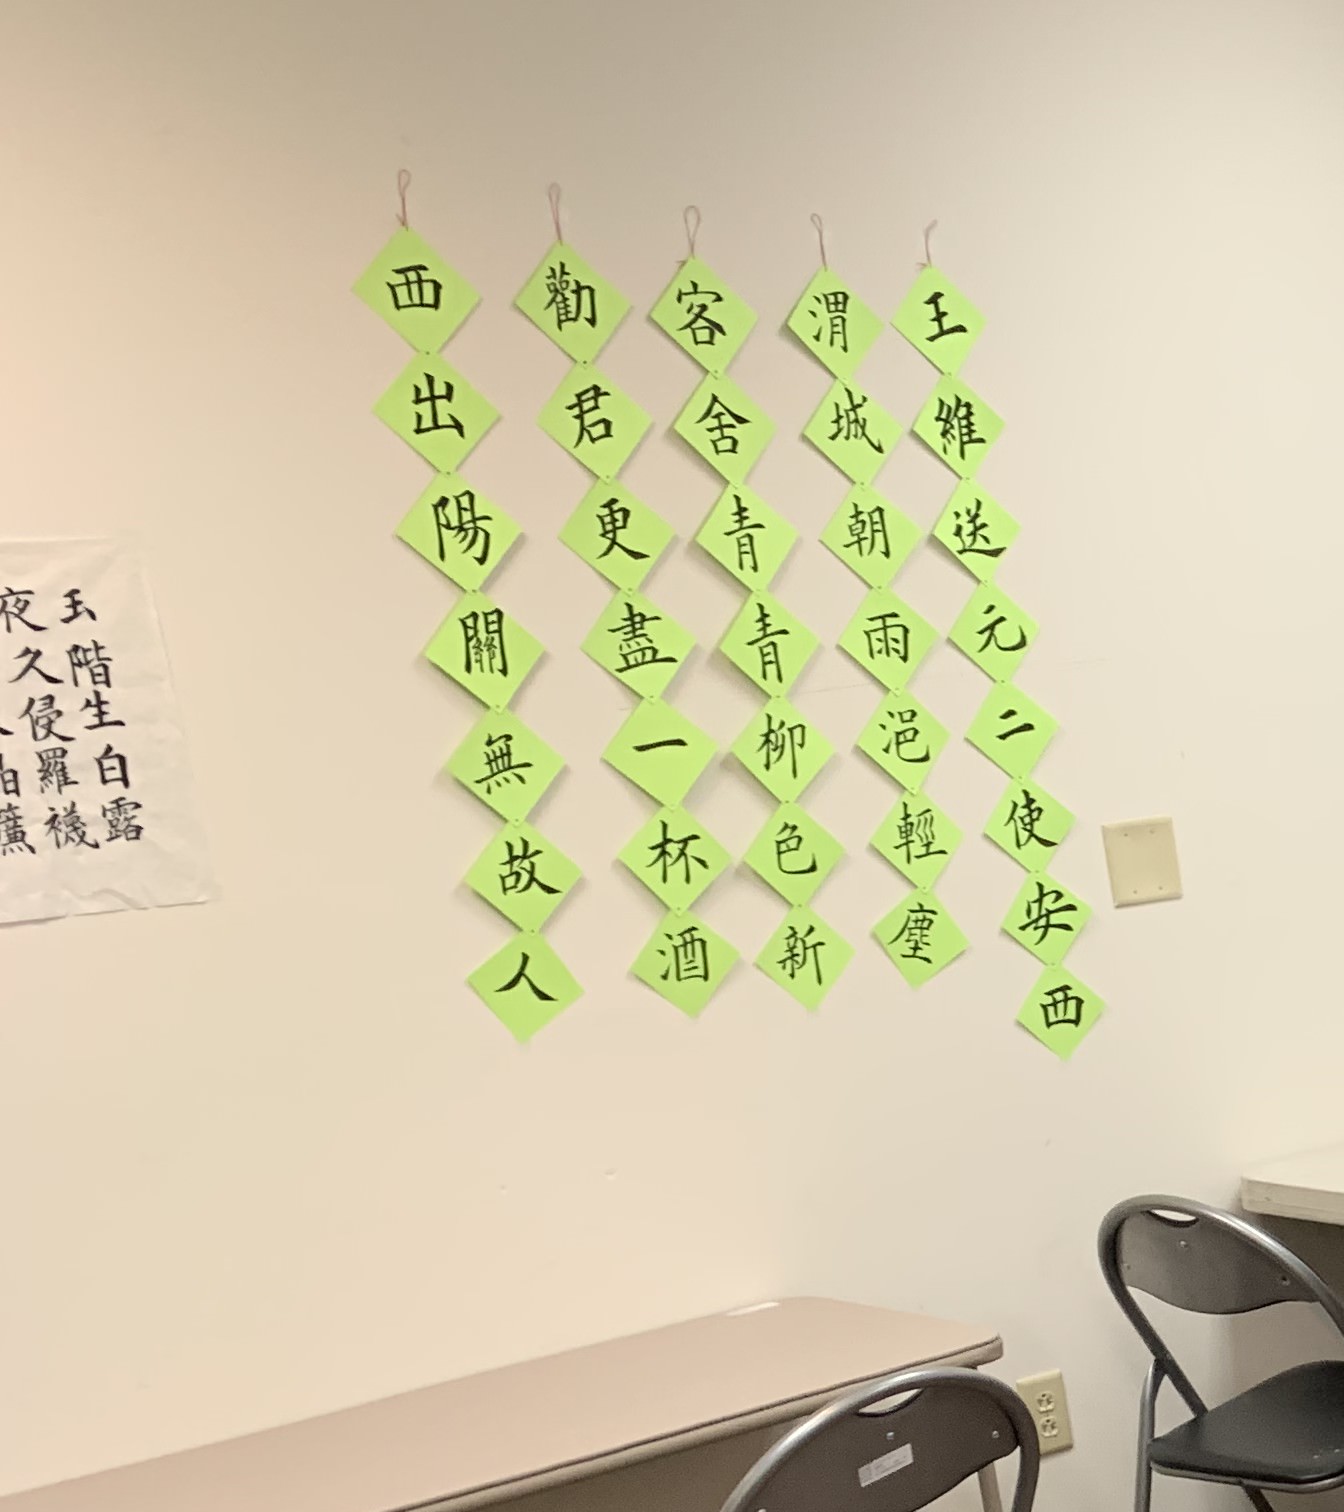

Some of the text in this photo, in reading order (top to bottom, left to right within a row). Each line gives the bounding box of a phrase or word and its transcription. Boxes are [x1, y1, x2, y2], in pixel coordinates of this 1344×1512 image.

[60, 588, 145, 843] 玉階生白露
[386, 263, 563, 1002] 西出陽關無故人
[544, 261, 710, 982] 勸君更盡一杯酒
[676, 280, 826, 986] 客舍青青柳色新
[808, 290, 949, 965] 渭城朝雨浥輕塵
[923, 291, 1085, 1029] 王維送元二使安西
